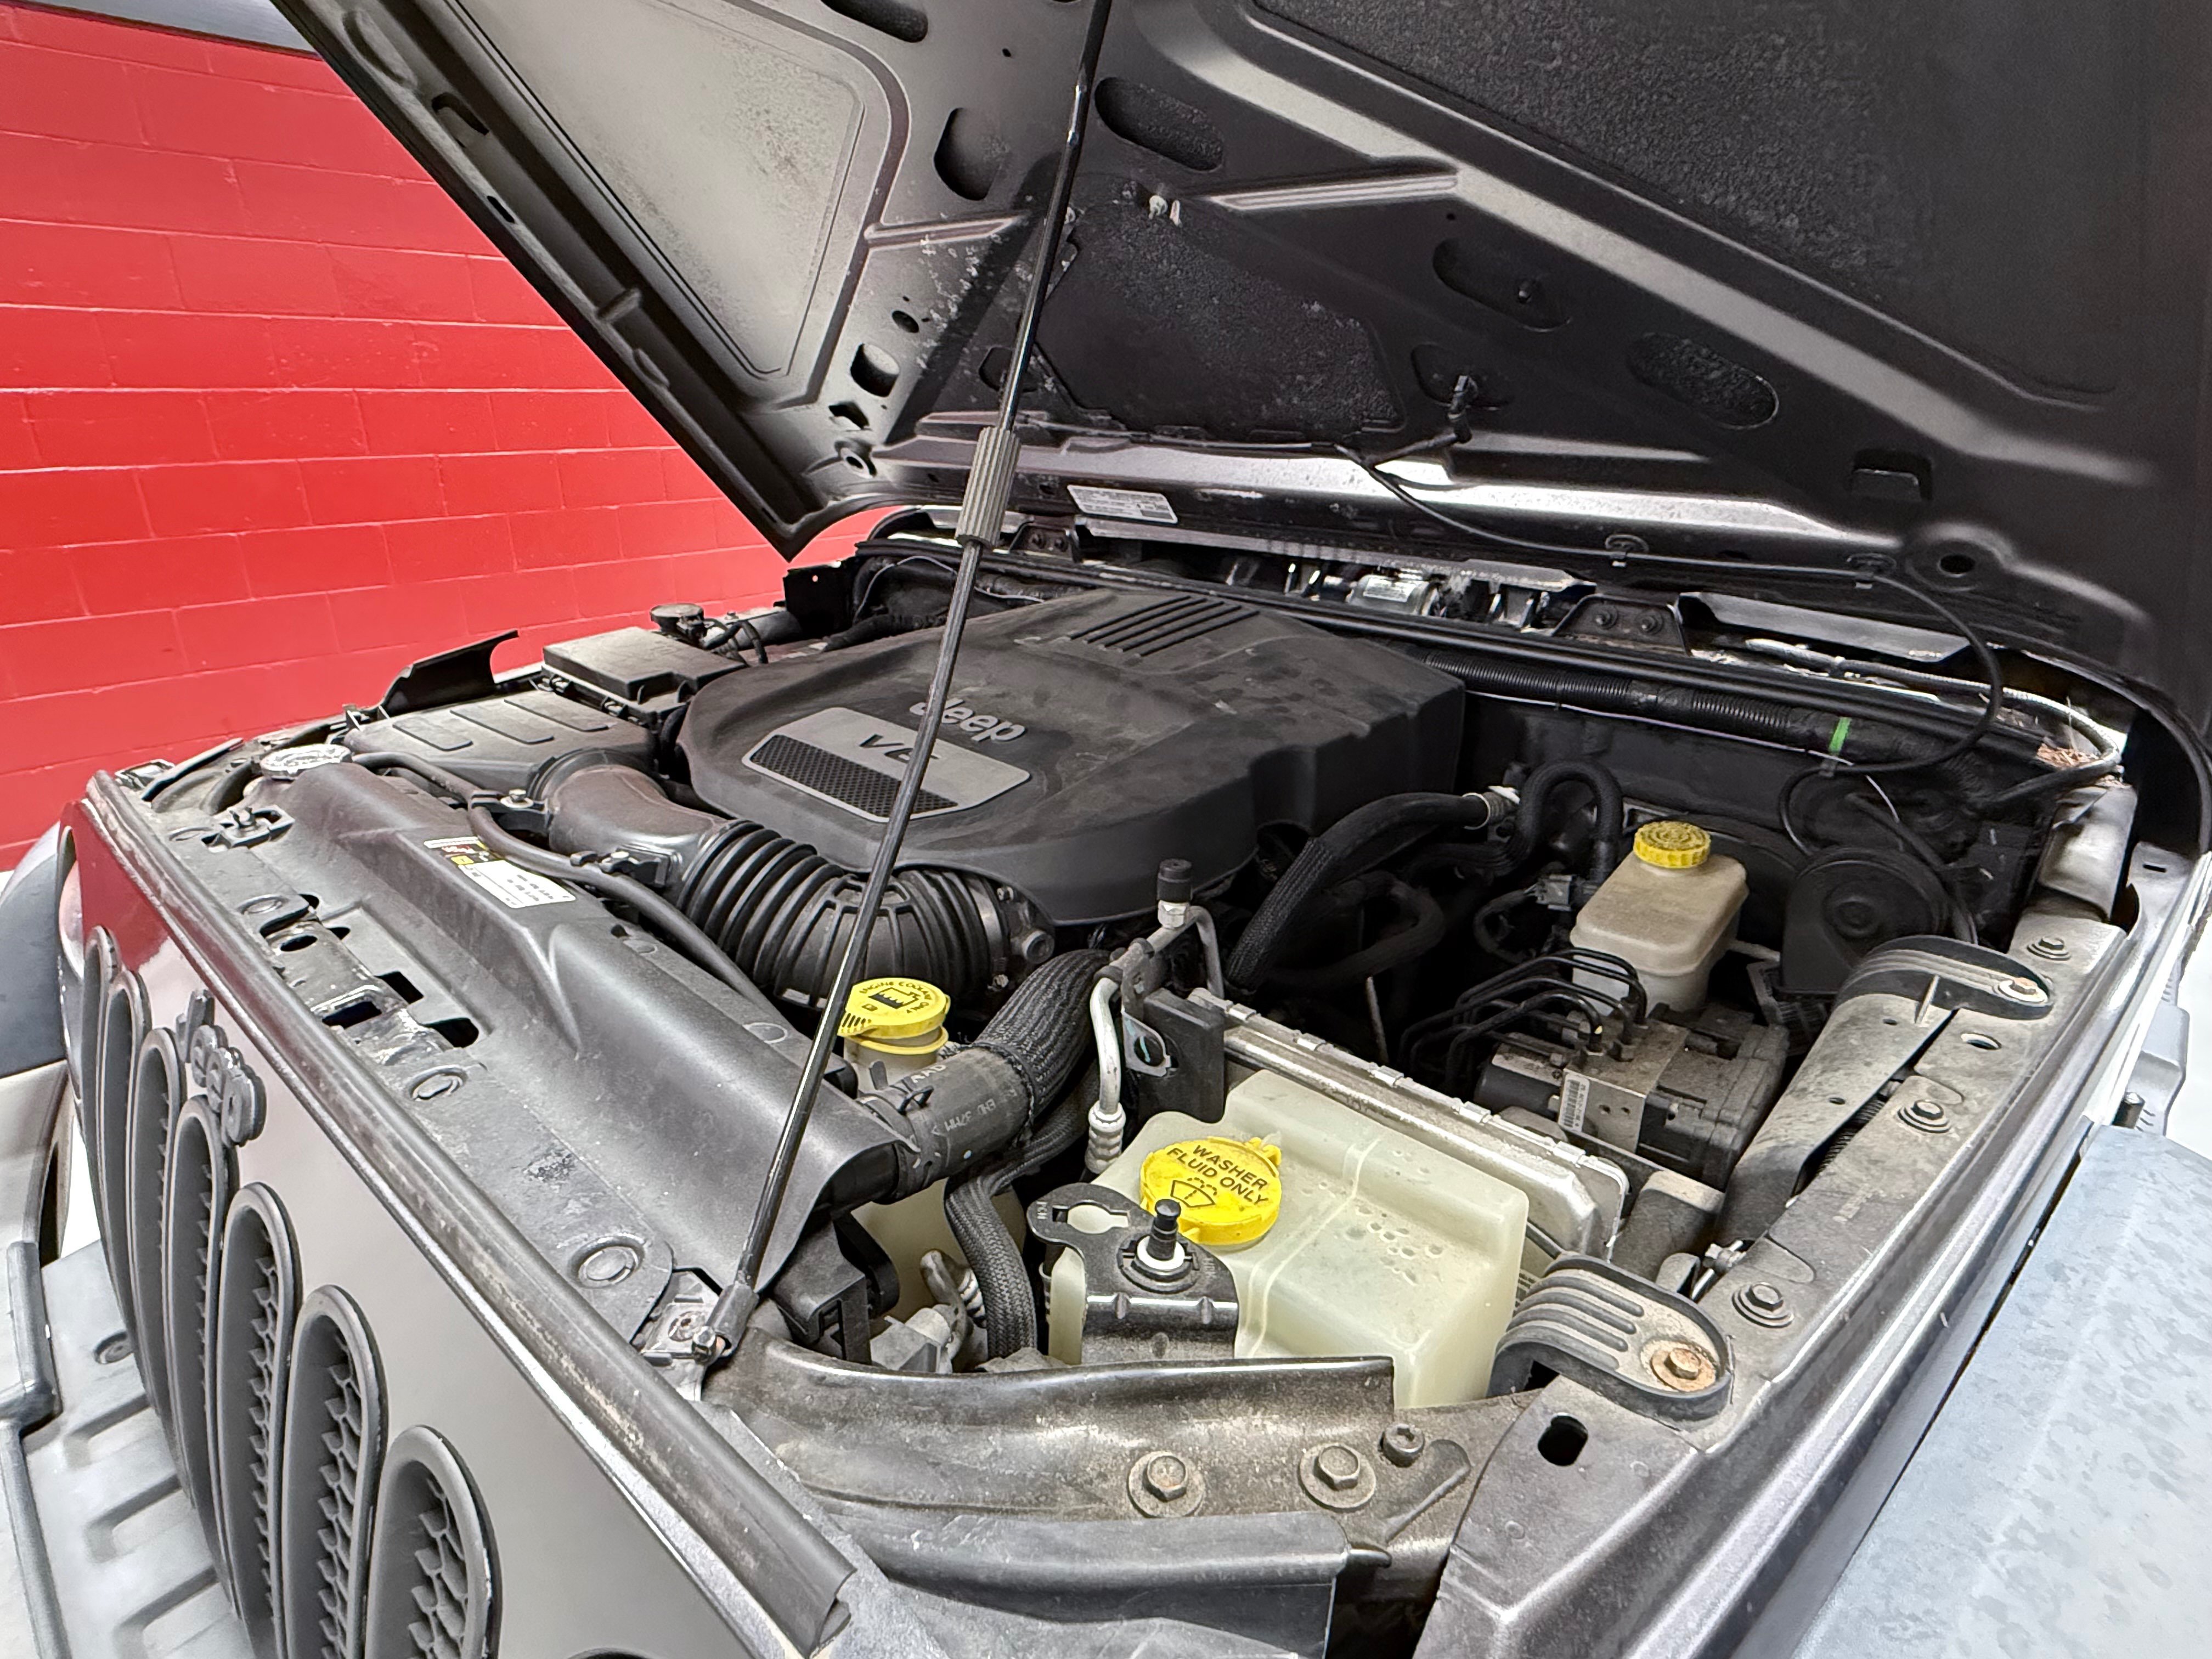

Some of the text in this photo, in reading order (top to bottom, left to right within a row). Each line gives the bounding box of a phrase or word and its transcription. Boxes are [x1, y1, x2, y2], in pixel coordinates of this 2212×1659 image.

[909, 697, 1026, 742] Jeep
[1166, 1147, 1269, 1206] FLUID ONLY
[1193, 1144, 1268, 1191] WASHER
